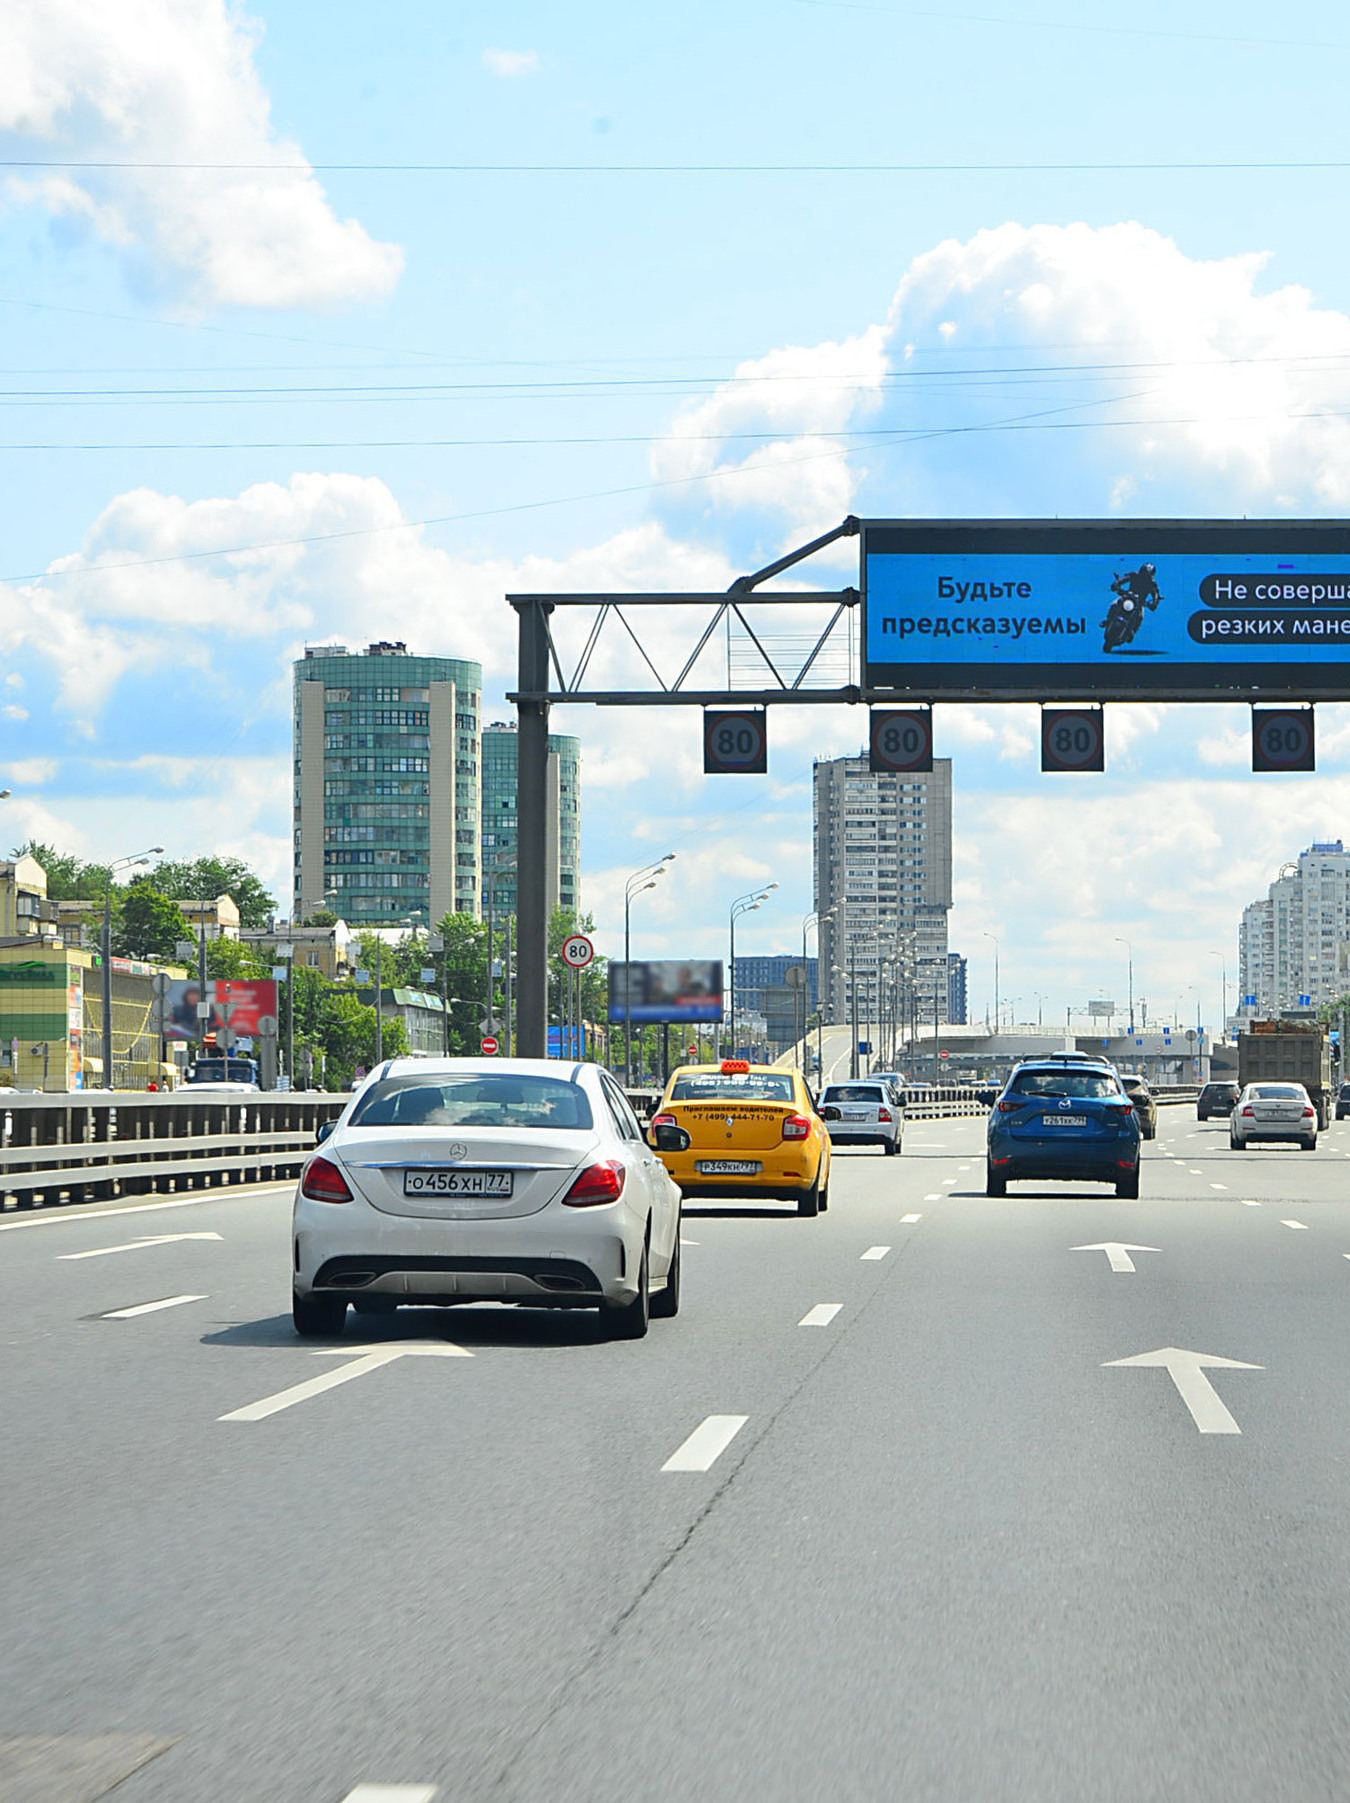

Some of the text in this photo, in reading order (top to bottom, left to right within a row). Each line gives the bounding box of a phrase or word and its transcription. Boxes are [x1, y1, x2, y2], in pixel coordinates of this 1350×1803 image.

[938, 576, 1032, 603] Будьте
[1215, 580, 1248, 599] Не
[882, 617, 1086, 639] предсказуемы
[1202, 620, 1284, 638] резких
[718, 729, 753, 754] 80
[884, 728, 919, 753] 80
[1055, 727, 1090, 752] 80
[1266, 727, 1301, 752] 80
[569, 945, 587, 958] 80
[412, 1174, 505, 1191] О456ХН 77
